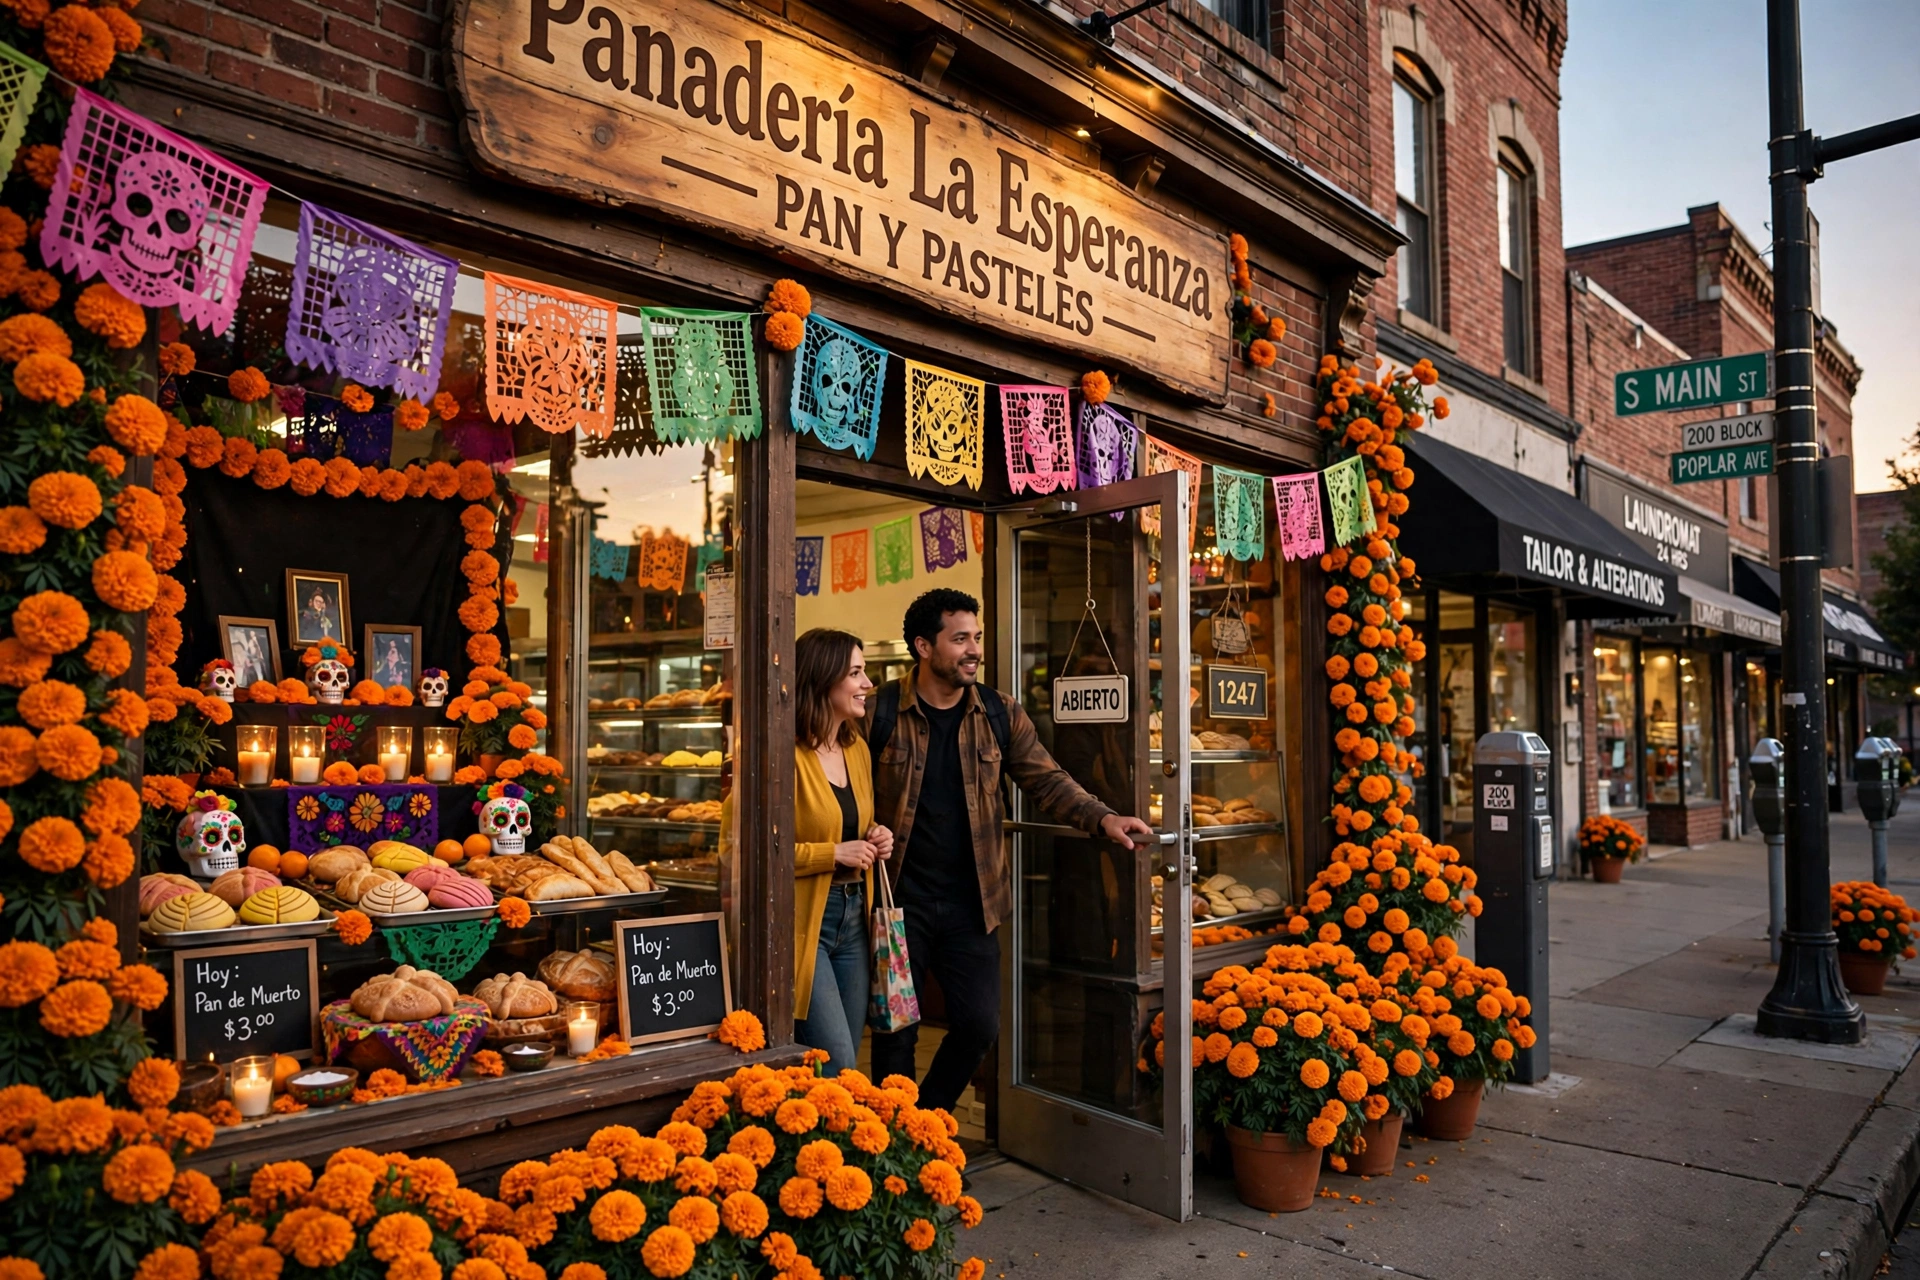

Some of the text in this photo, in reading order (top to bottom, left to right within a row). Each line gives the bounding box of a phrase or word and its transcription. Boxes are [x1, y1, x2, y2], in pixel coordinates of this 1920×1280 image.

[522, 0, 1212, 321] Panadería La Esperanza
[774, 174, 1093, 336] PAN Y PASTELES
[1623, 364, 1757, 409] S MAIN ST
[1687, 419, 1763, 446] 200 BLOCK
[1678, 450, 1768, 478] POPLAR AVE
[1624, 494, 1701, 555] LAUNDROMAT
[1656, 543, 1669, 563] 24
[1522, 535, 1665, 606] TAILOR & ALTERATIONS
[1060, 687, 1120, 711] ABIERTO
[1217, 679, 1258, 706] 1247
[1488, 786, 1509, 799] 200
[632, 933, 671, 960] Hoy:
[196, 962, 240, 989] Hoy:
[631, 959, 717, 986] Pan de Muerto
[195, 984, 301, 1014] Pan de Muerto
[652, 989, 695, 1017] $3.00
[224, 1012, 275, 1041] $3.00
